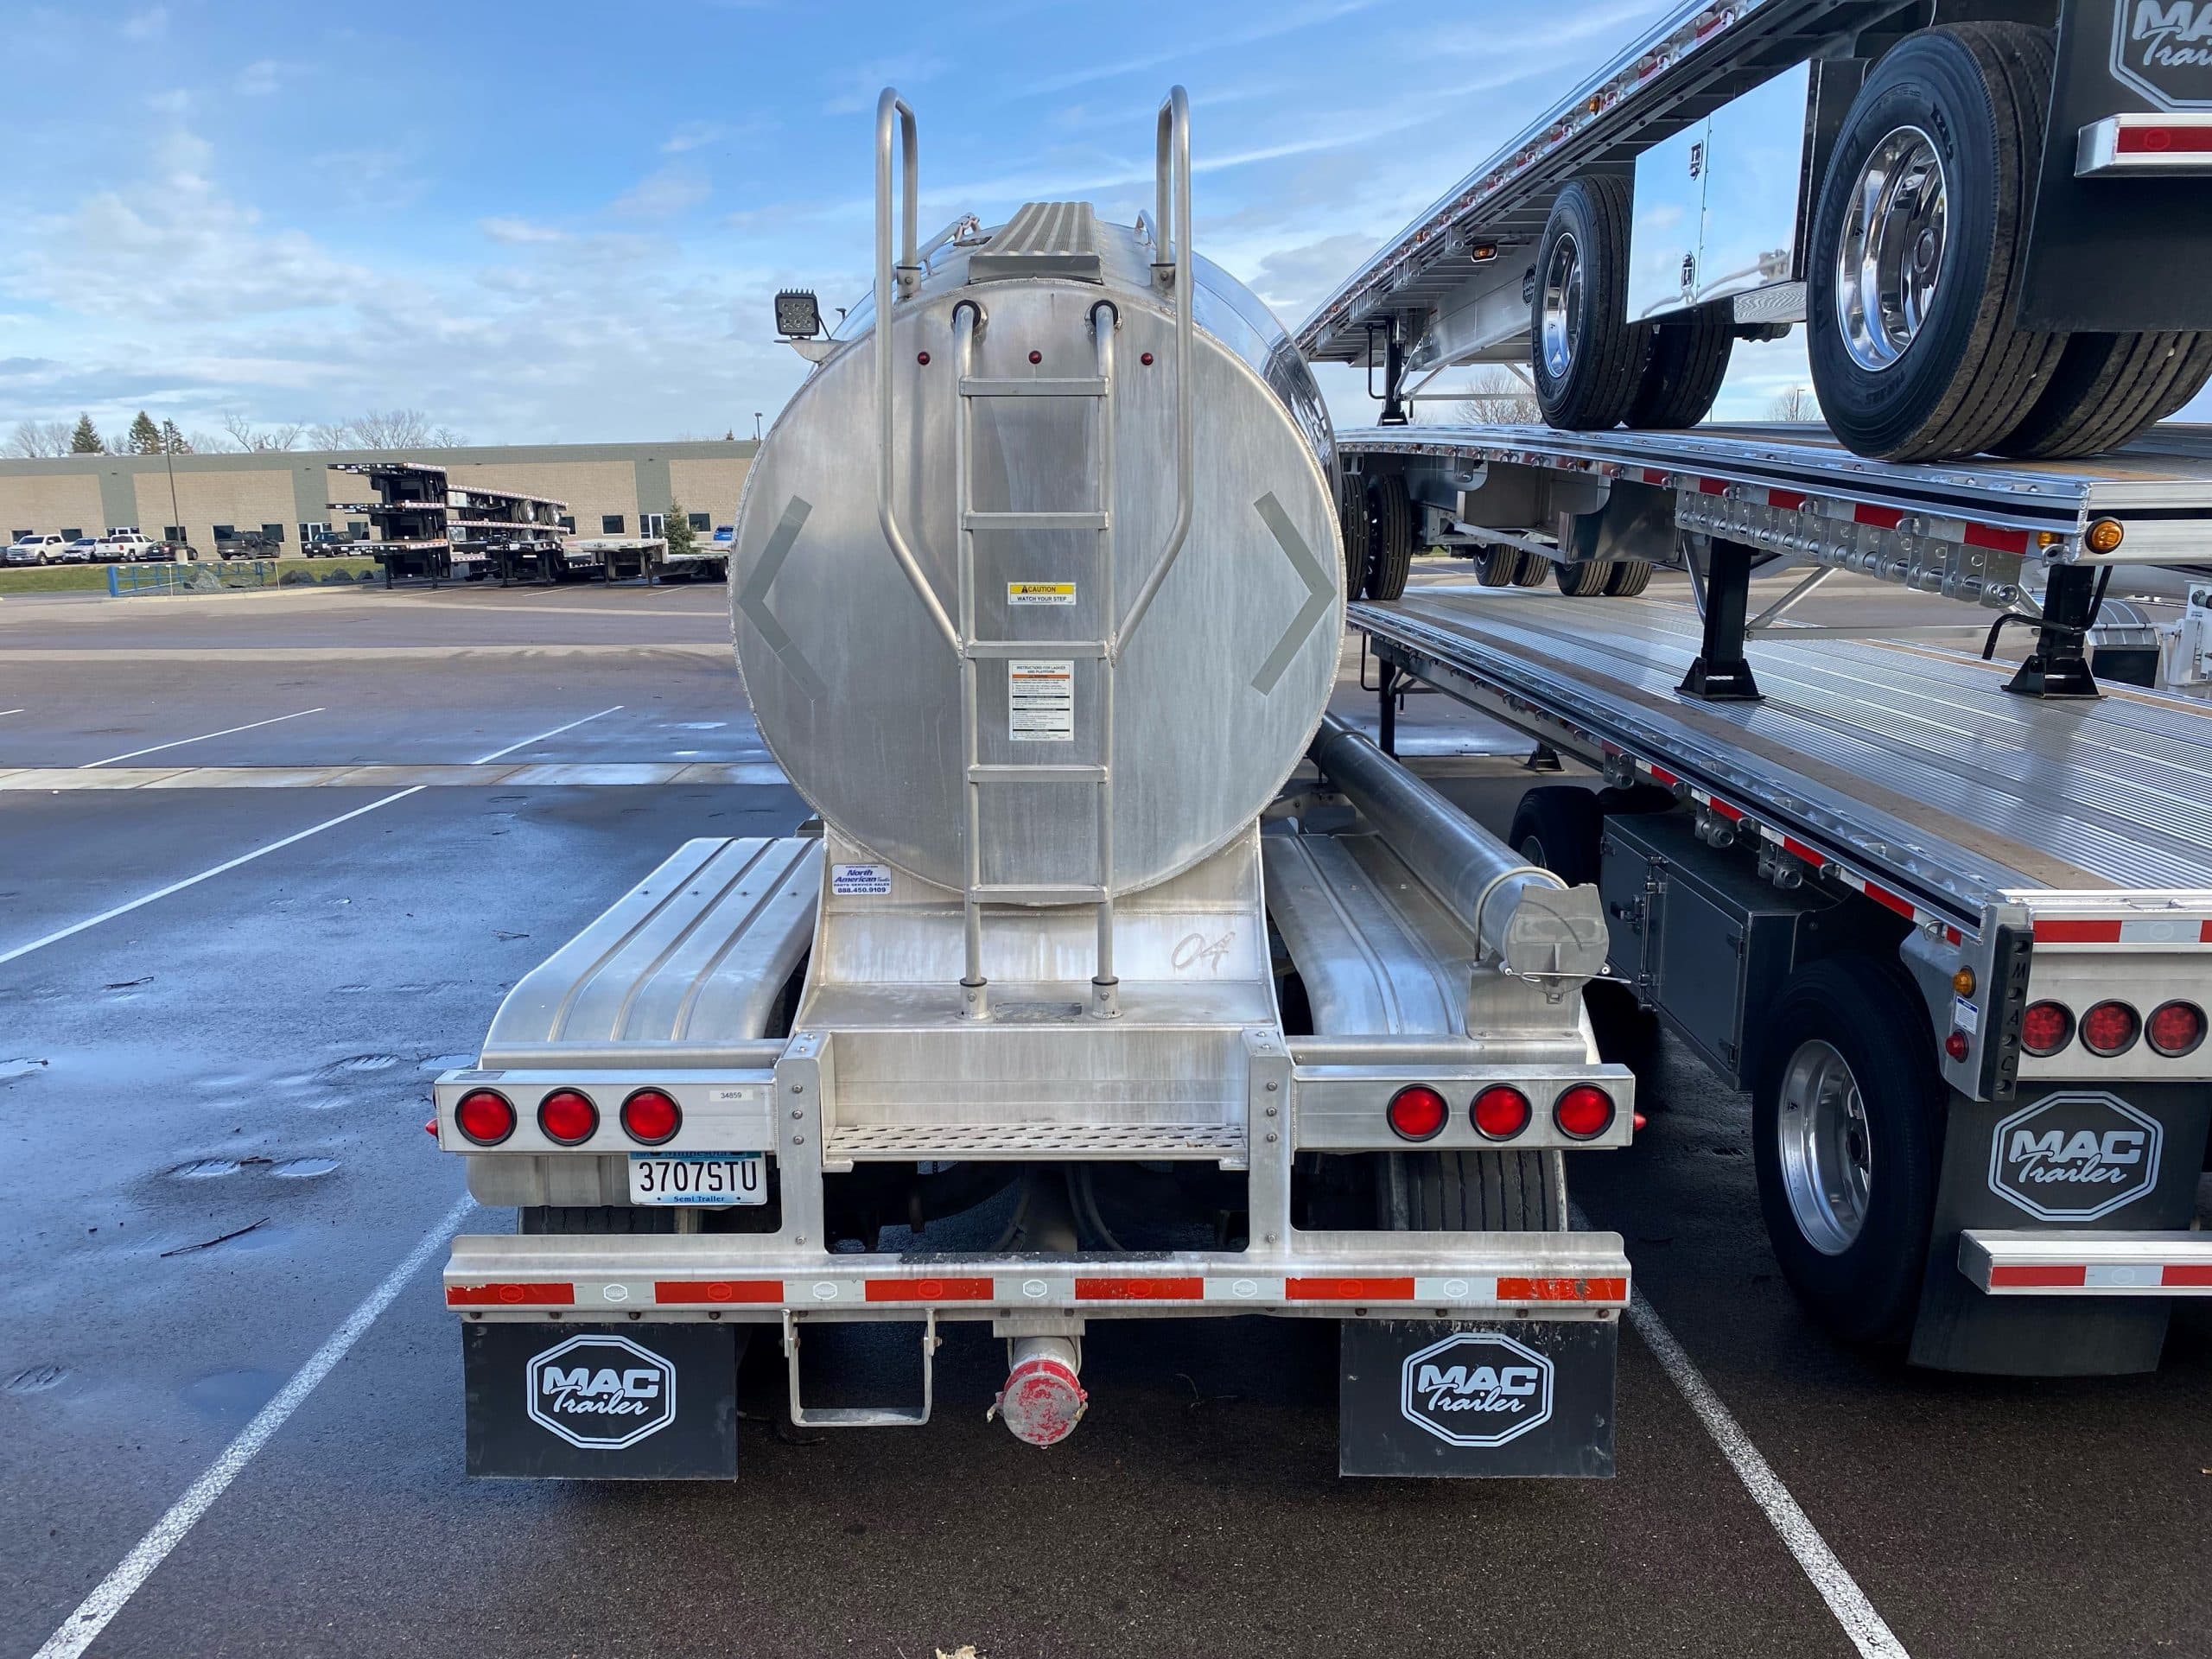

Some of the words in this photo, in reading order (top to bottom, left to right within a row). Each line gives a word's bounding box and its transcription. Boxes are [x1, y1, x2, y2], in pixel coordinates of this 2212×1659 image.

[2009, 1130, 2145, 1164] MAC
[639, 1161, 757, 1192] 3707STU
[2016, 1150, 2127, 1183] Trailer
[542, 1366, 660, 1398] MAC
[1417, 1364, 1538, 1395] MAC
[550, 1384, 649, 1415] Trailer
[1425, 1382, 1526, 1413] Trailer
